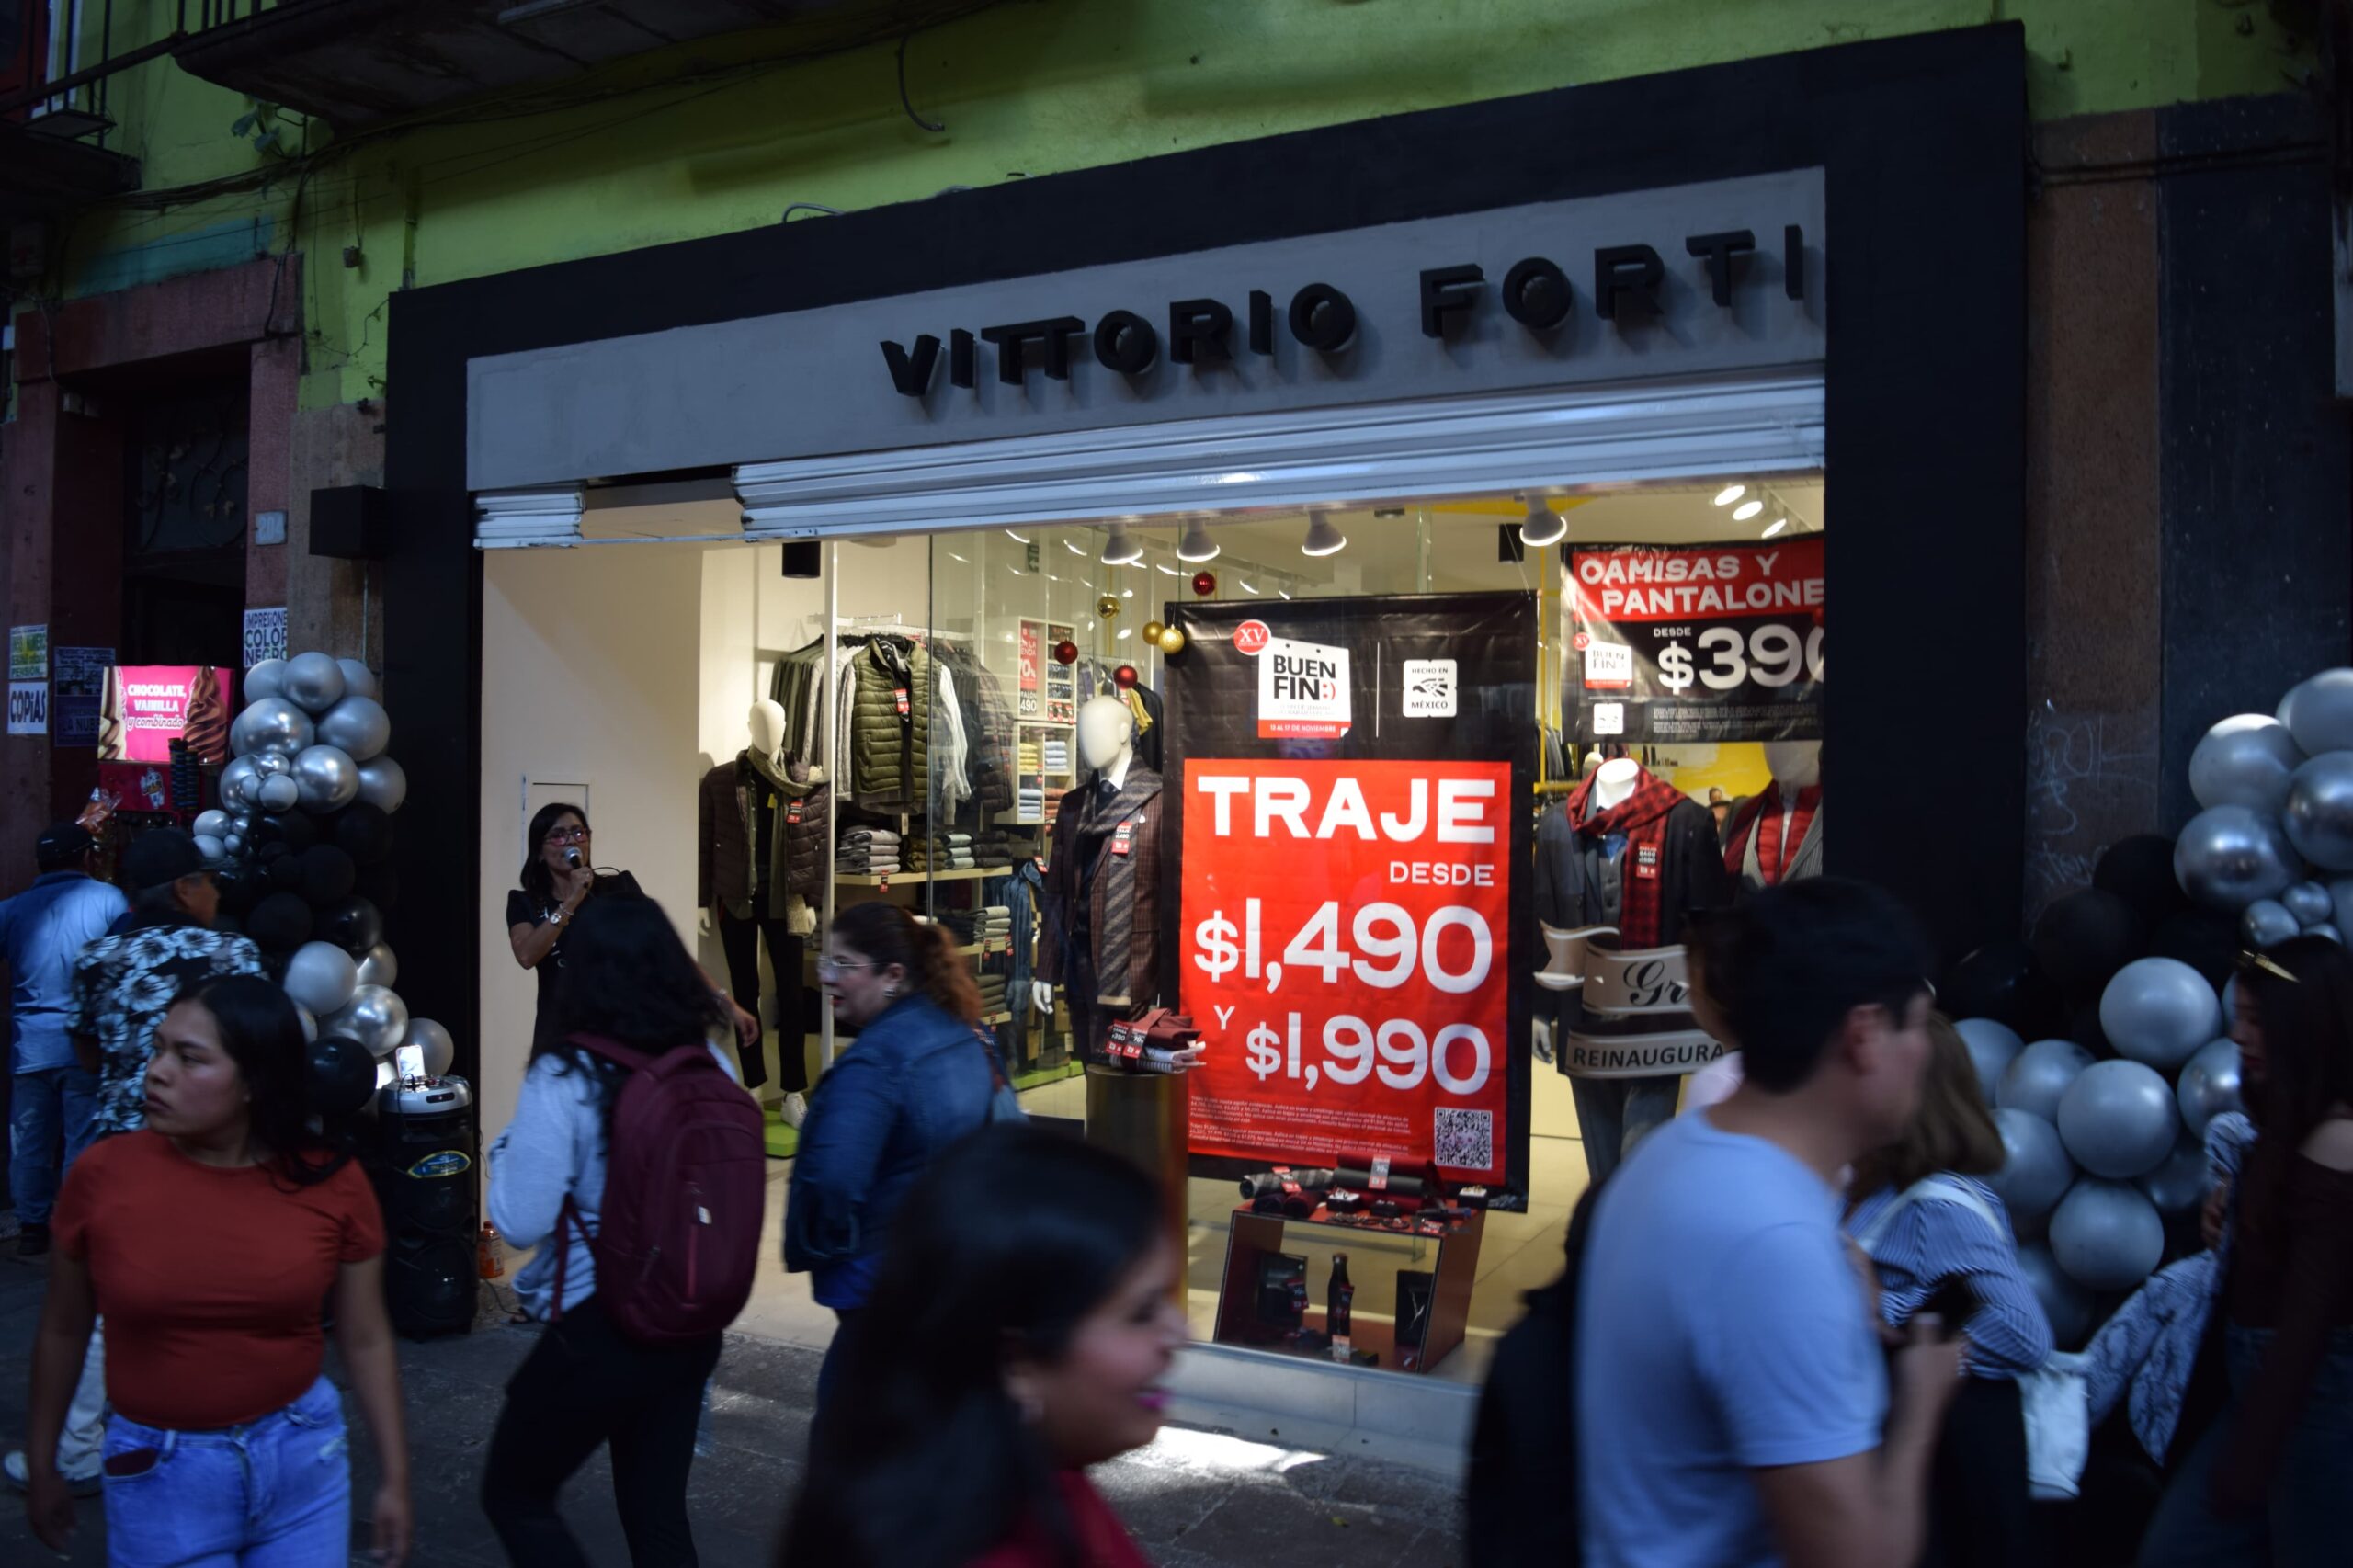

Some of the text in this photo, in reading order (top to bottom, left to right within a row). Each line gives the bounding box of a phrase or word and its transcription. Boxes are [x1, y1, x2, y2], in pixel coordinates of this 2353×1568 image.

[881, 223, 1802, 397] VITTORIO FORTI
[1755, 551, 1779, 577] Y
[1239, 628, 1265, 642] XV
[1654, 627, 1691, 637] DESDE
[1274, 654, 1336, 678] BUEN
[134, 699, 179, 712] VAINILLA
[135, 714, 184, 729] combinado
[1197, 776, 1495, 843] TRAJE
[1390, 861, 1494, 886] DESDE
[1194, 897, 1493, 994] $1,490
[1213, 1005, 1235, 1030] Y
[1245, 1012, 1492, 1095] $1,990
[1573, 1044, 1724, 1068] REINAUGURA
